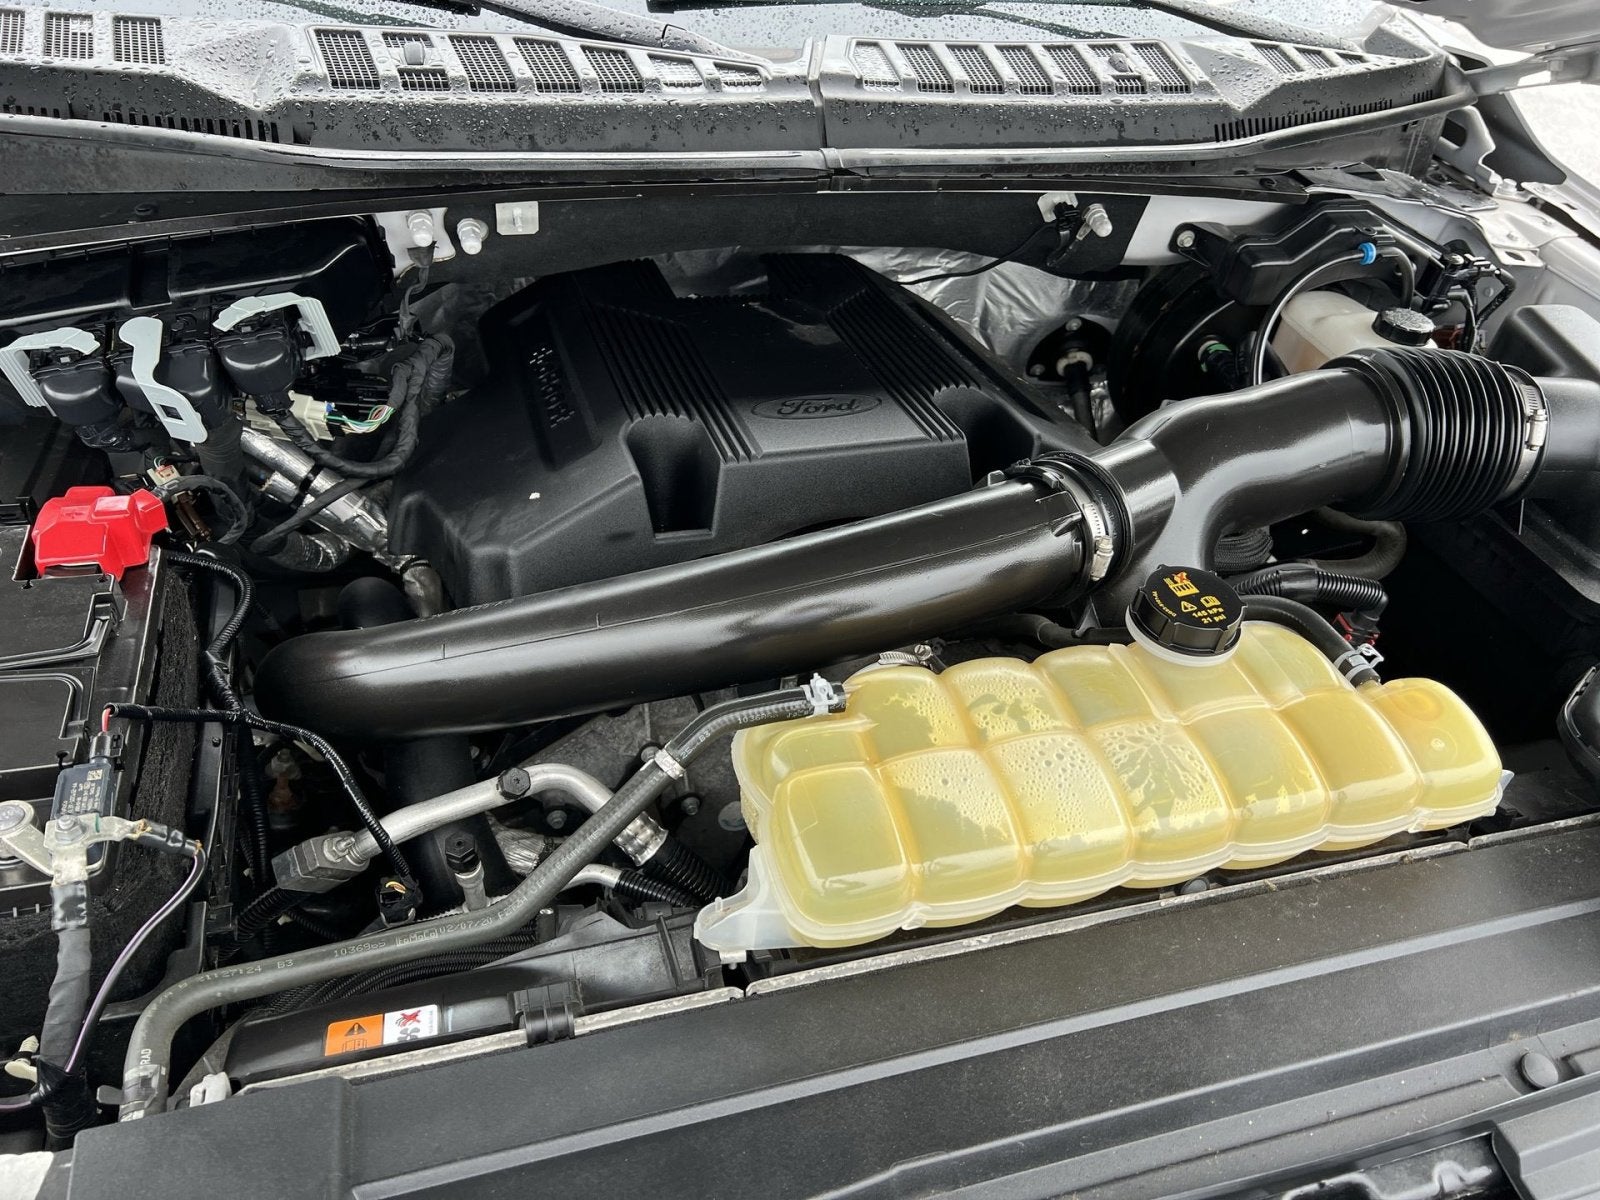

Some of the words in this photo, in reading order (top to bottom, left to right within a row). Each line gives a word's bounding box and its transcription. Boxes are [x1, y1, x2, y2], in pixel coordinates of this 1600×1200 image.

[776, 397, 860, 416] Ford
[1201, 616, 1213, 624] 21
[1213, 613, 1227, 623] psi
